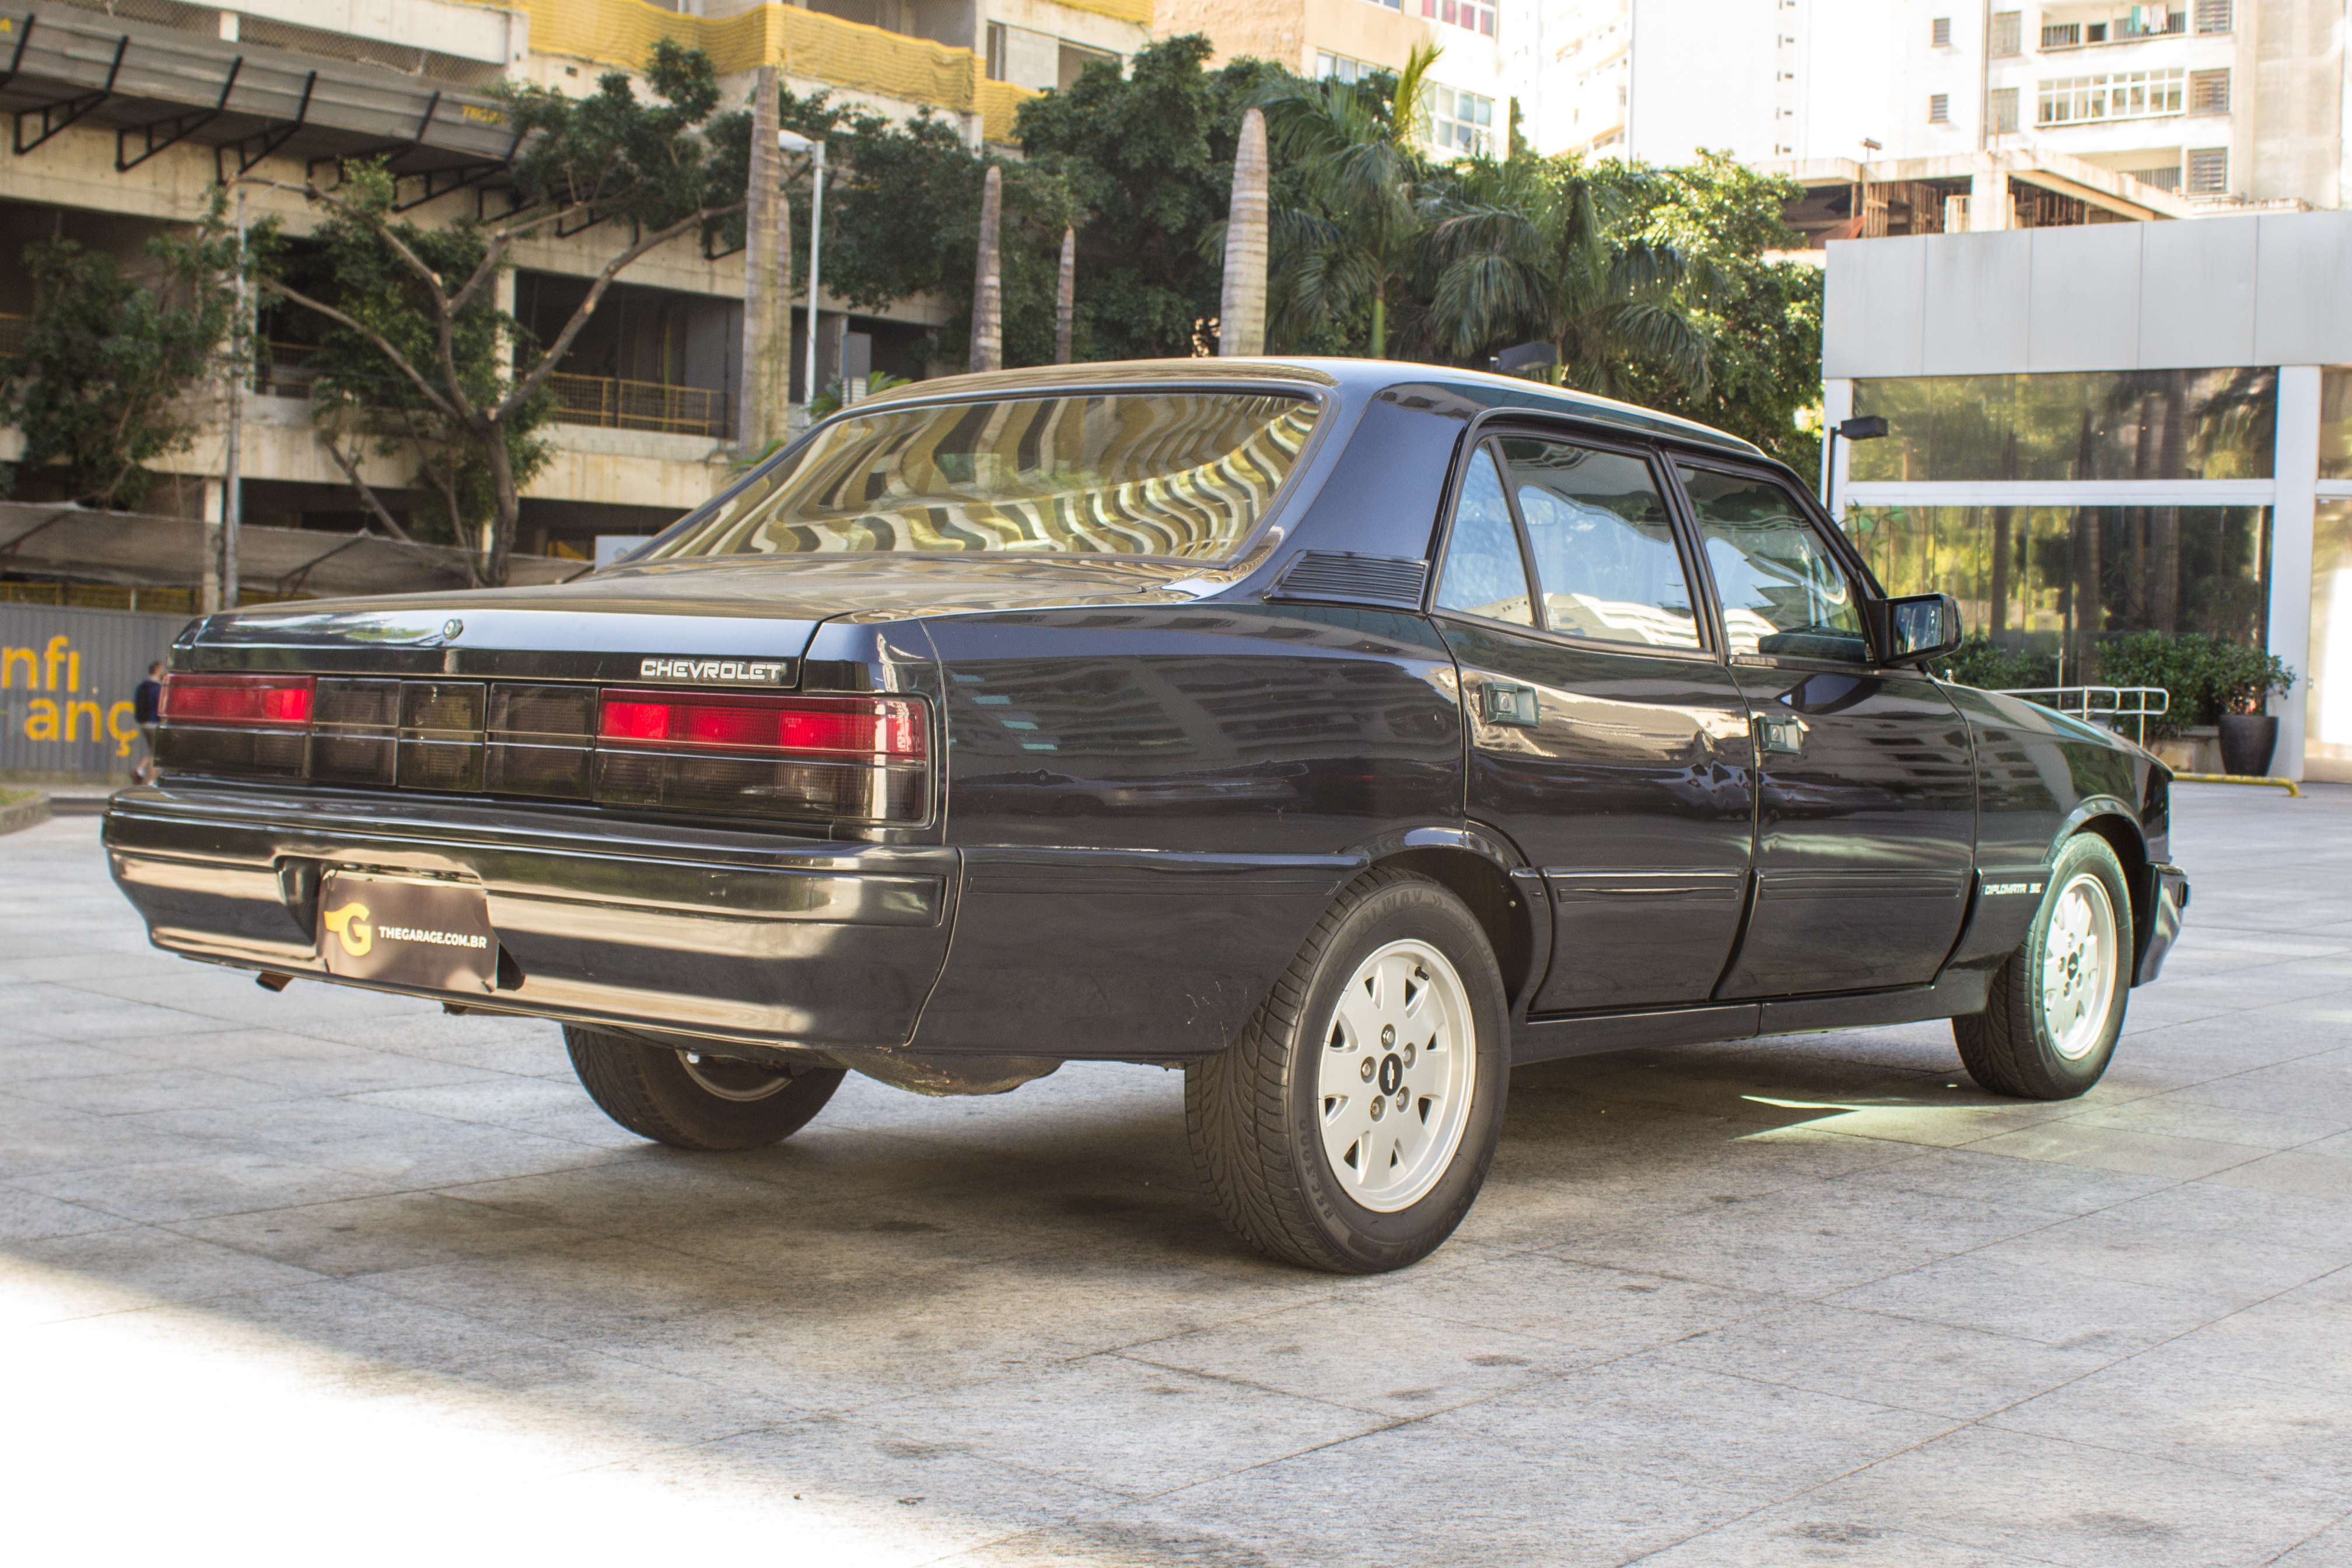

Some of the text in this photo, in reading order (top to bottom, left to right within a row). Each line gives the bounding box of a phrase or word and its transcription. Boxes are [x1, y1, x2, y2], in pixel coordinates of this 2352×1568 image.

[640, 659, 782, 680] CHEVROLET
[1985, 883, 2027, 895] DIPLOMATA
[379, 925, 488, 949] THEGARAGE.COM.BR
